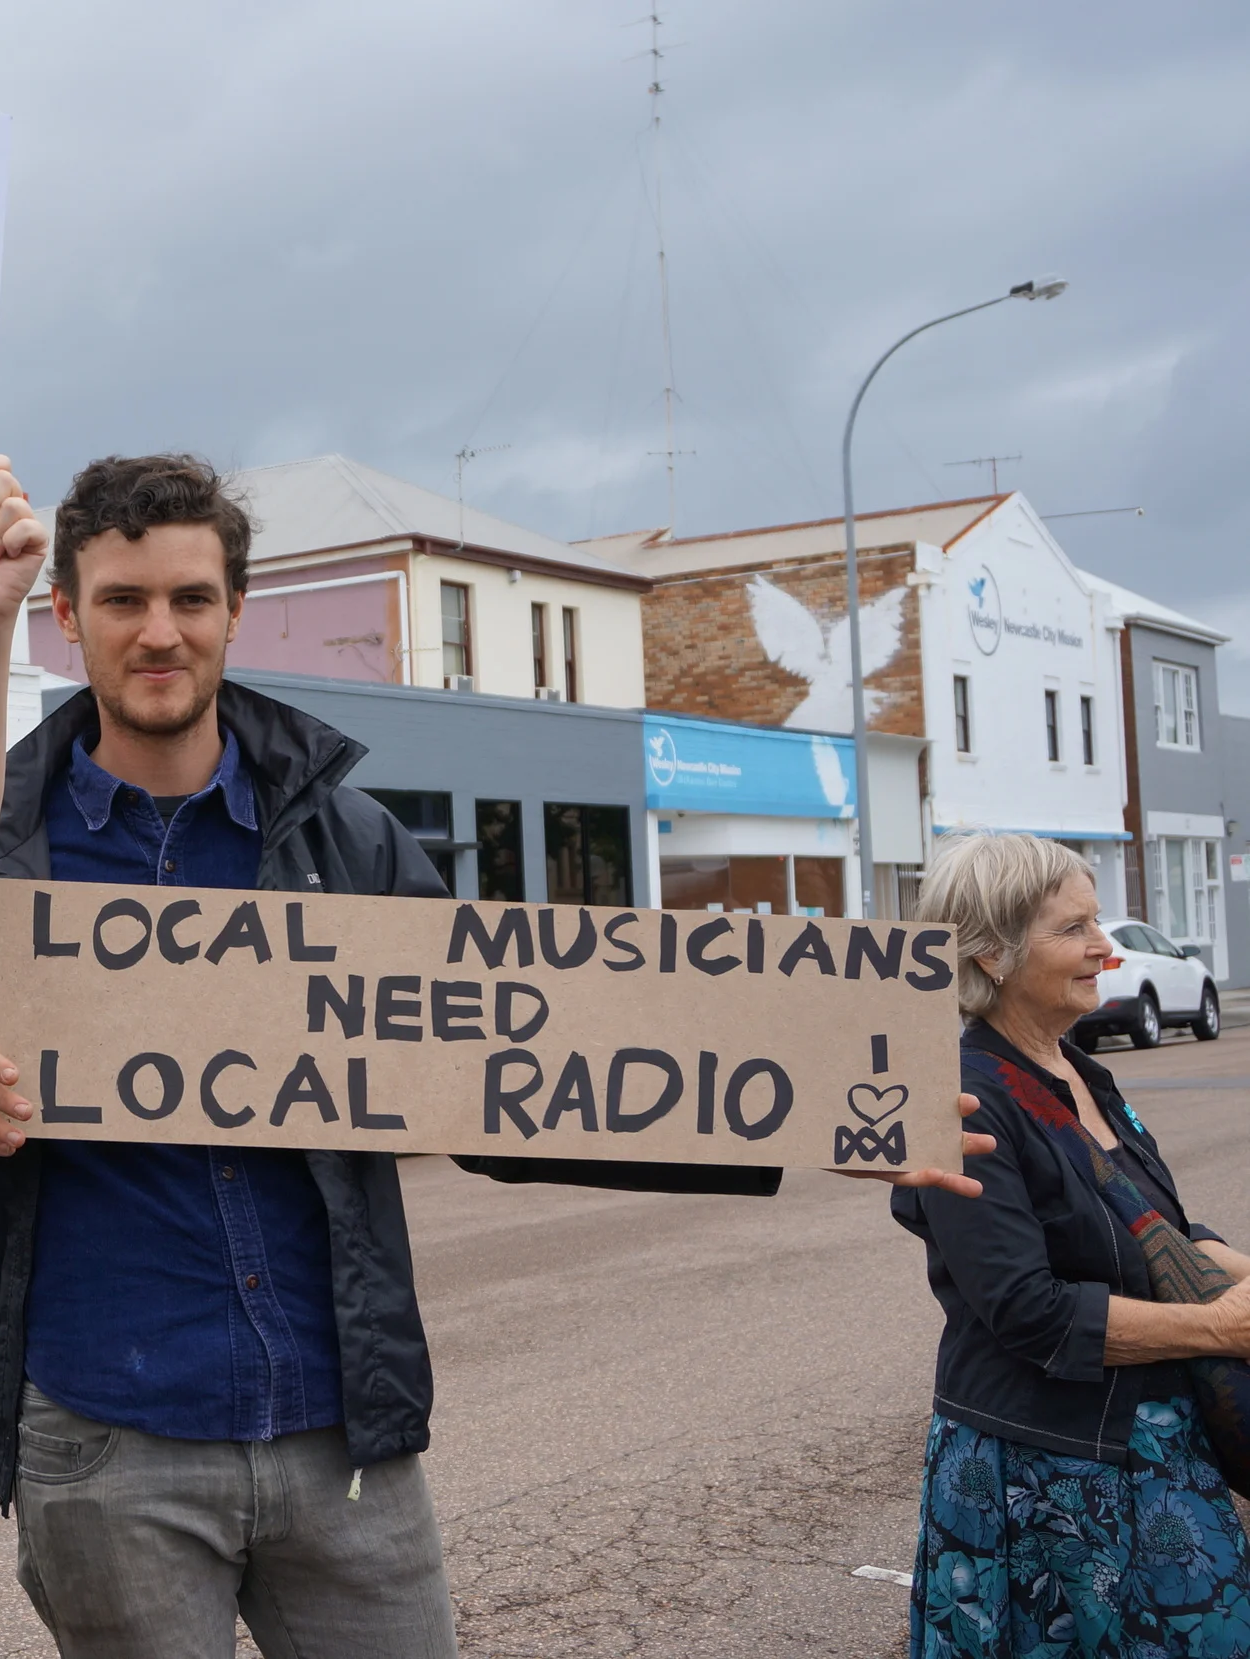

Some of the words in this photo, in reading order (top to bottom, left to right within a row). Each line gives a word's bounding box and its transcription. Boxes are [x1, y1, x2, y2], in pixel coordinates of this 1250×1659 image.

[970, 610, 998, 635] Wesley
[1003, 616, 1041, 640] Newcastle
[1042, 625, 1056, 647] City
[1057, 628, 1084, 649] Mission
[33, 891, 337, 970] LOCAL
[446, 903, 954, 992] MUSICIANS
[307, 973, 550, 1043] NEED
[40, 1049, 407, 1130] LOCAL
[484, 1048, 794, 1140] RADIO
